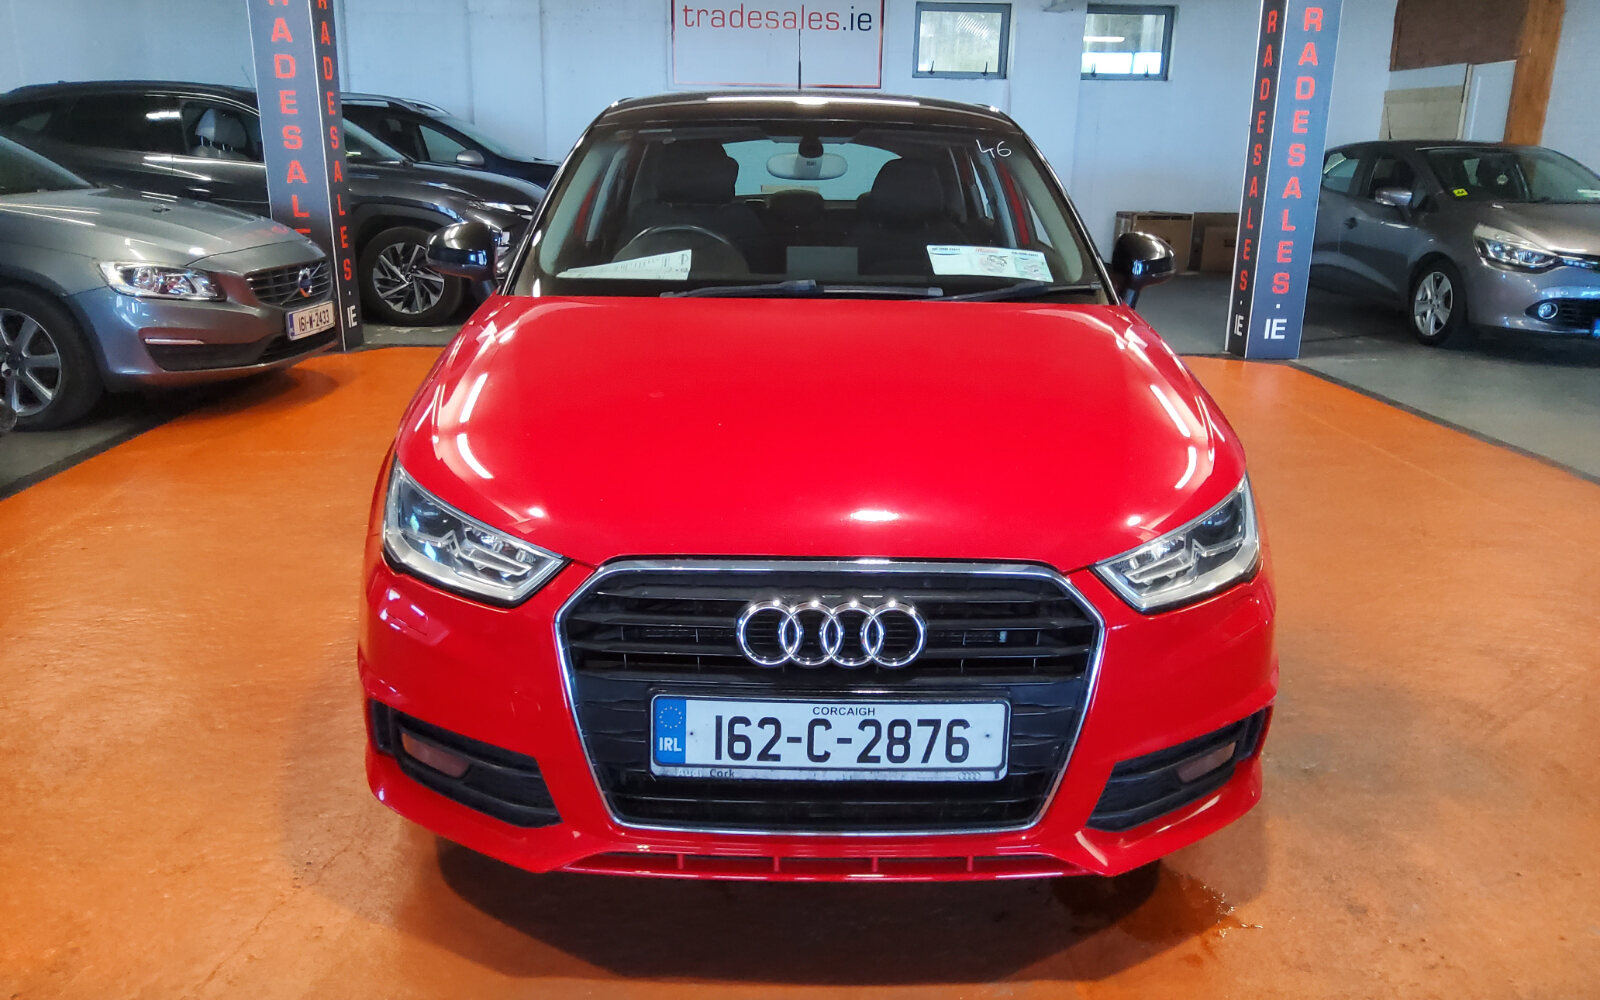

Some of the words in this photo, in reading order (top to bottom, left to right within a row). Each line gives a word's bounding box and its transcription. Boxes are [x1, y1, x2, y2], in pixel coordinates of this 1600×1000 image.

[683, 3, 872, 31] tradesales.ie
[267, 0, 311, 238] ADESAL
[975, 138, 1012, 159] 46
[812, 706, 876, 717] CORCAIGH
[659, 736, 683, 752] IRL
[714, 714, 971, 765] 162-C-2876
[709, 768, 735, 778] Cork
